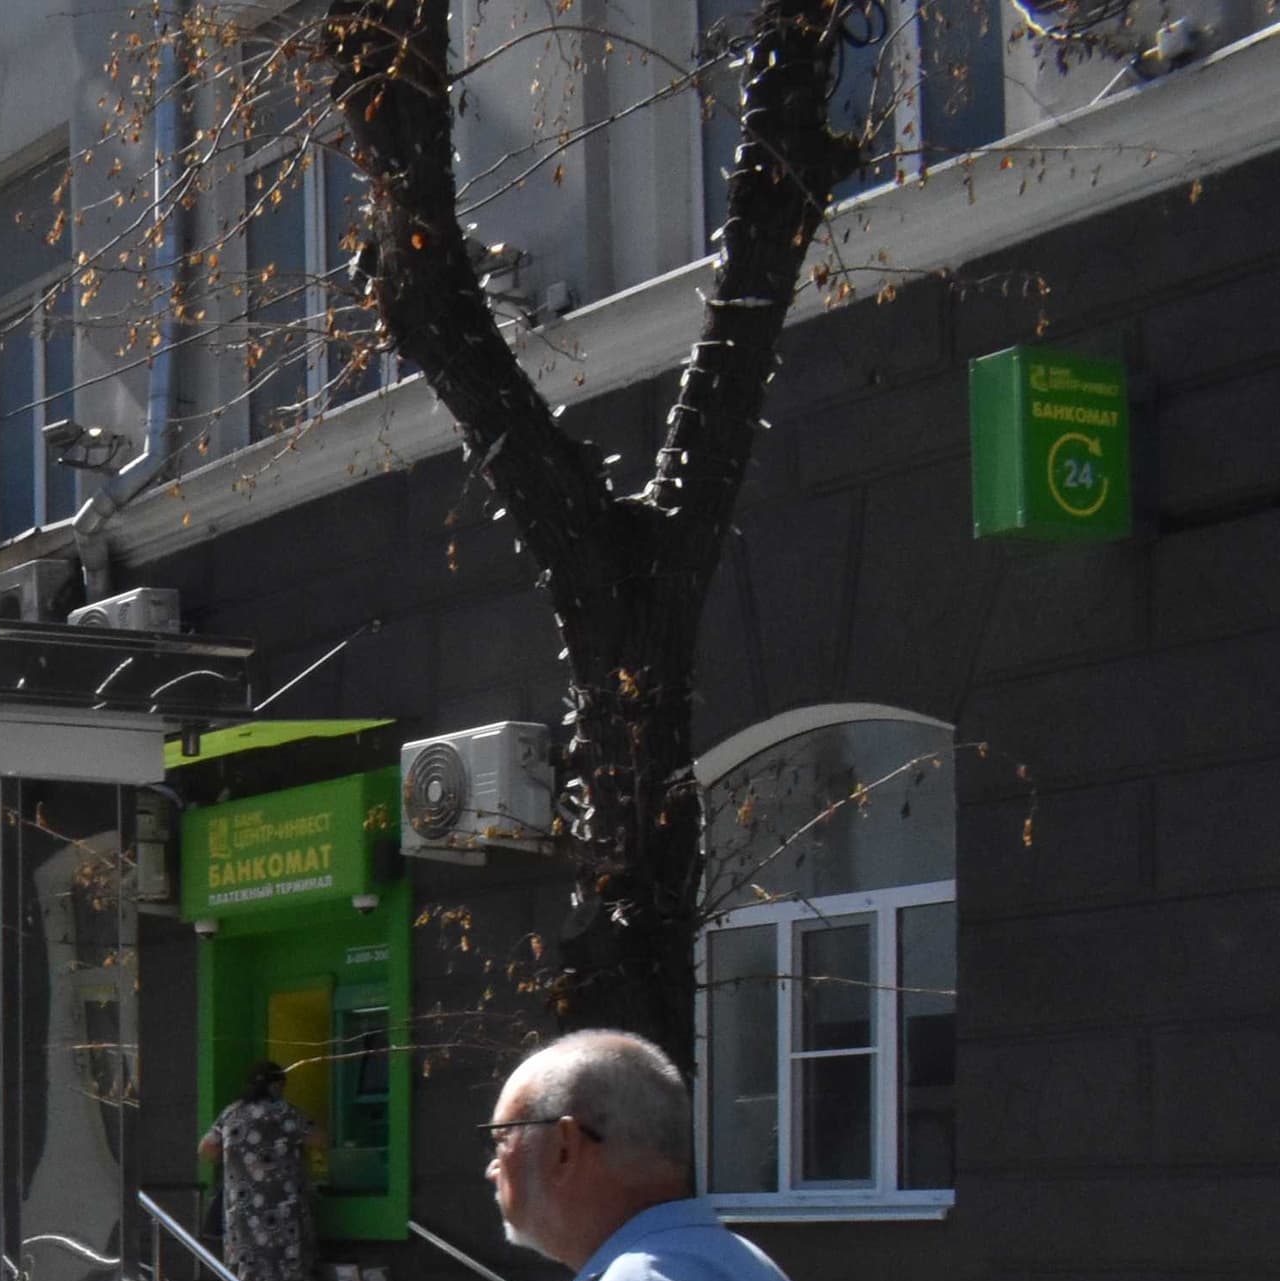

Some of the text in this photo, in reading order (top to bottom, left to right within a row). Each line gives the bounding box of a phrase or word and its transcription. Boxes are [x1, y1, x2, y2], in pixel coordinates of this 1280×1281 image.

[1032, 401, 1118, 427] БАНКОМАТ
[1063, 459, 1093, 488] 24
[208, 843, 332, 889] БАНКОМАТ
[208, 875, 333, 907] ПЛАТЕЖНЫЙ ТЕРМИНАЛ
